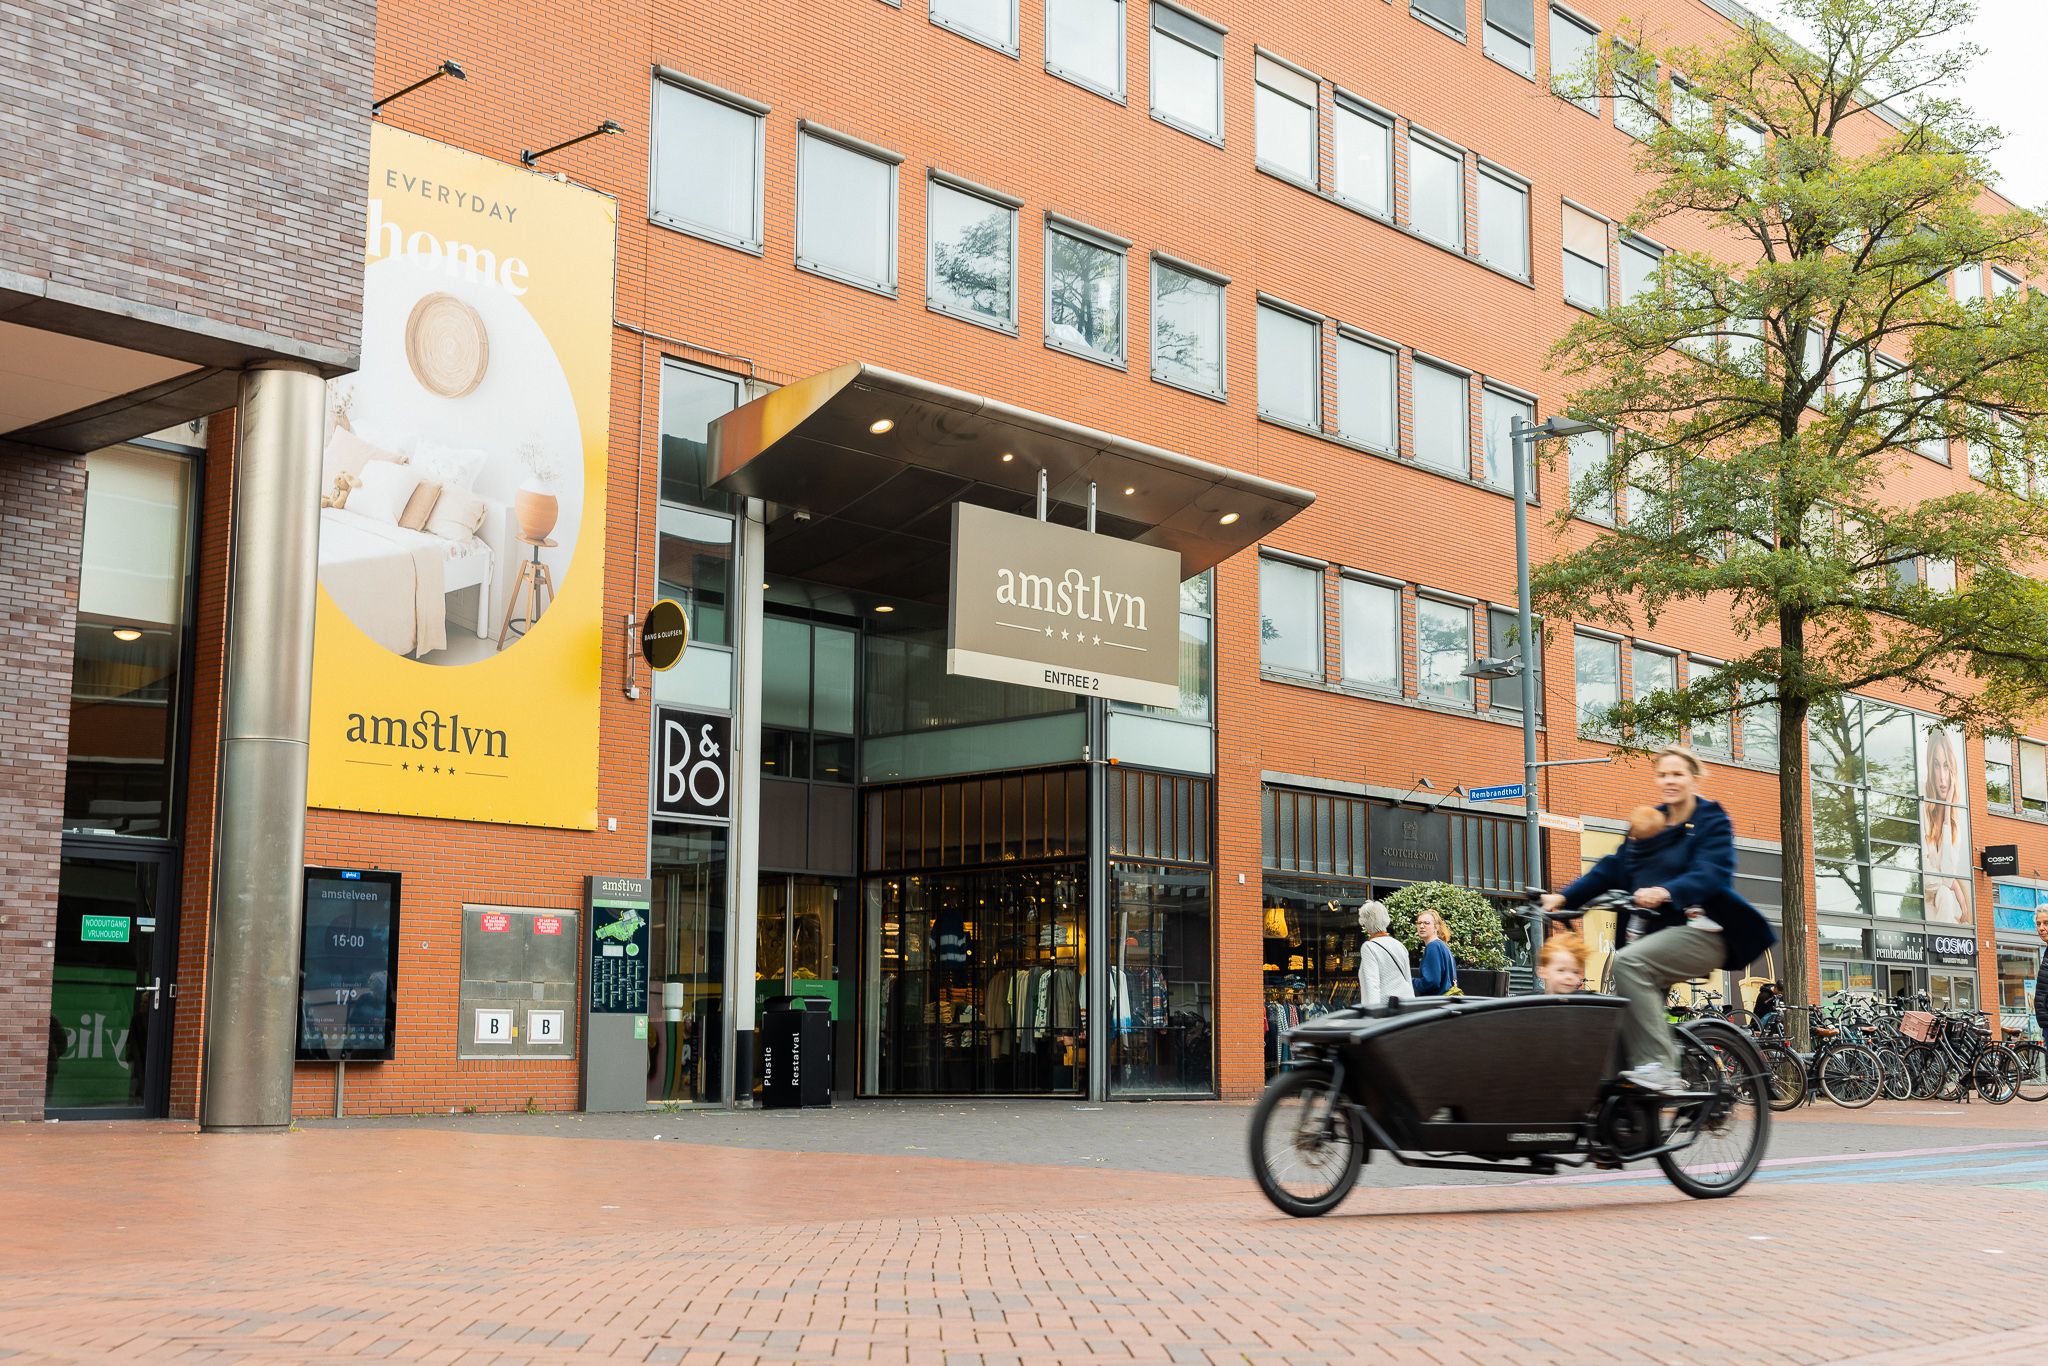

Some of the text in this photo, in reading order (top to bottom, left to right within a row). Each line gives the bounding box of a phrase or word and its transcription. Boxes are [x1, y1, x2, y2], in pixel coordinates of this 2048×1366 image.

[386, 169, 517, 223] EVERYDAY
[367, 199, 529, 297] home
[996, 568, 1148, 631] amstlvn
[662, 629, 682, 638] OLUFSEN
[1044, 670, 1099, 690] ENTREE 2
[346, 710, 509, 758] amstlvn
[1471, 787, 1520, 799] Rembrandthof
[602, 879, 642, 892] amstlvn
[322, 890, 378, 900] amstelveen
[86, 919, 127, 928] NOODUITGANG
[1876, 944, 1924, 960] rembrandthof
[1936, 936, 1974, 956] COSMO
[336, 990, 357, 1006] 17°
[490, 1018, 499, 1034] B
[542, 1019, 550, 1034] B
[792, 1032, 800, 1086] Restafval
